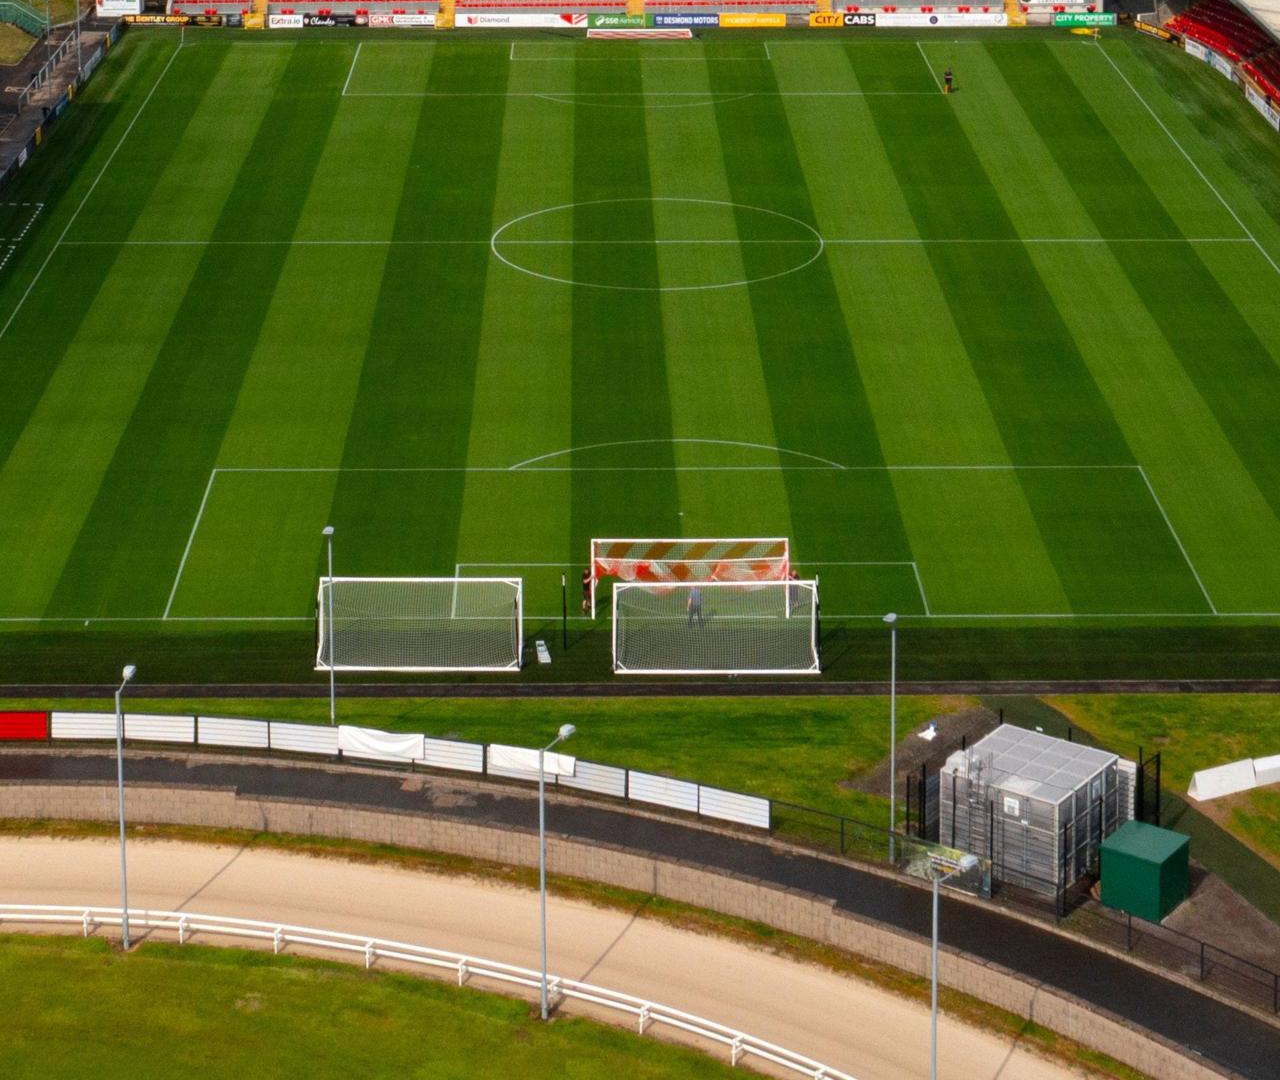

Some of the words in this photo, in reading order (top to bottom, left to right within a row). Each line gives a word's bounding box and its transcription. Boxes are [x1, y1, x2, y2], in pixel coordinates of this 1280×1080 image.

[480, 16, 510, 24] Diamond
[663, 16, 693, 25] DESMOND
[694, 16, 719, 25] MOTORS
[815, 15, 839, 25] CITY
[844, 14, 875, 25] CABS
[1074, 14, 1114, 23] PROPERTY
